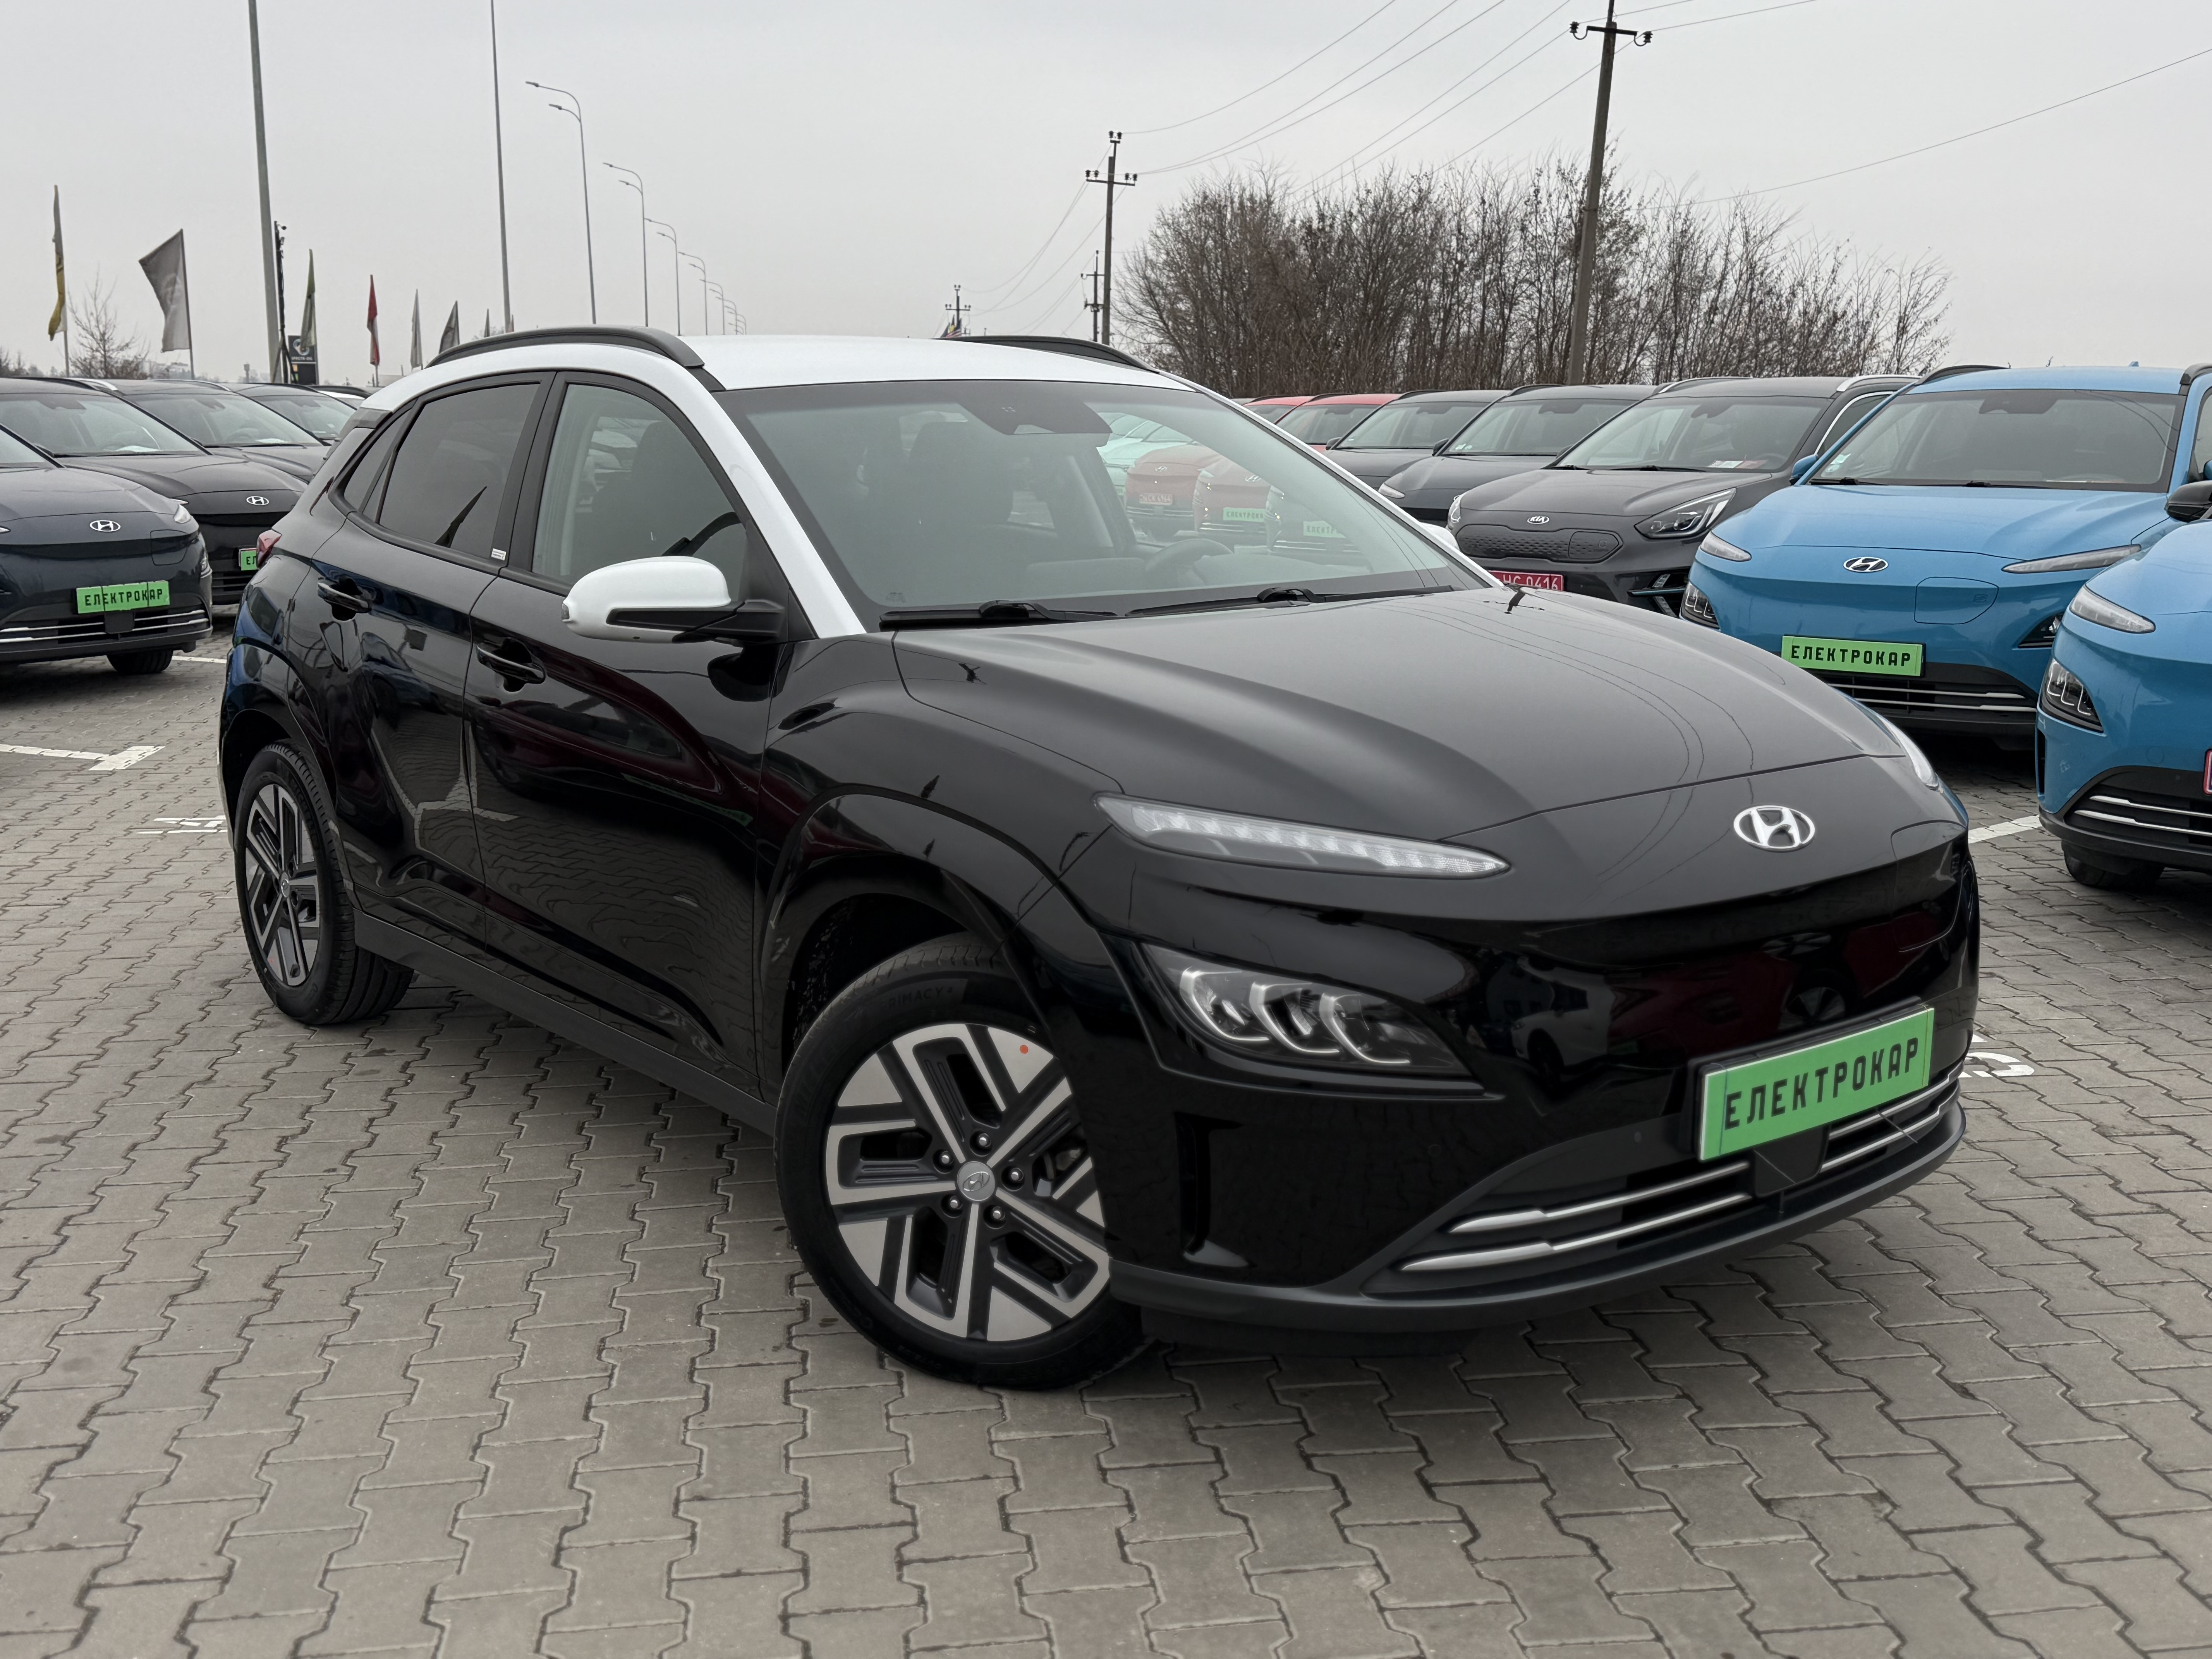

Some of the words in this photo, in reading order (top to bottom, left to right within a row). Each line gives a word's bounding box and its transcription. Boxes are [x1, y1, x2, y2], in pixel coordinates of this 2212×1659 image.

[1307, 526, 1336, 534] ЕЛЕКТР
[1526, 577, 1558, 590] 0416
[84, 588, 163, 606] ЕЛЕКТРОКАР
[1791, 645, 1910, 666] ЕЛЕКТРОКАР
[1724, 1037, 1918, 1130] ЕЛЕКТРОКАР
